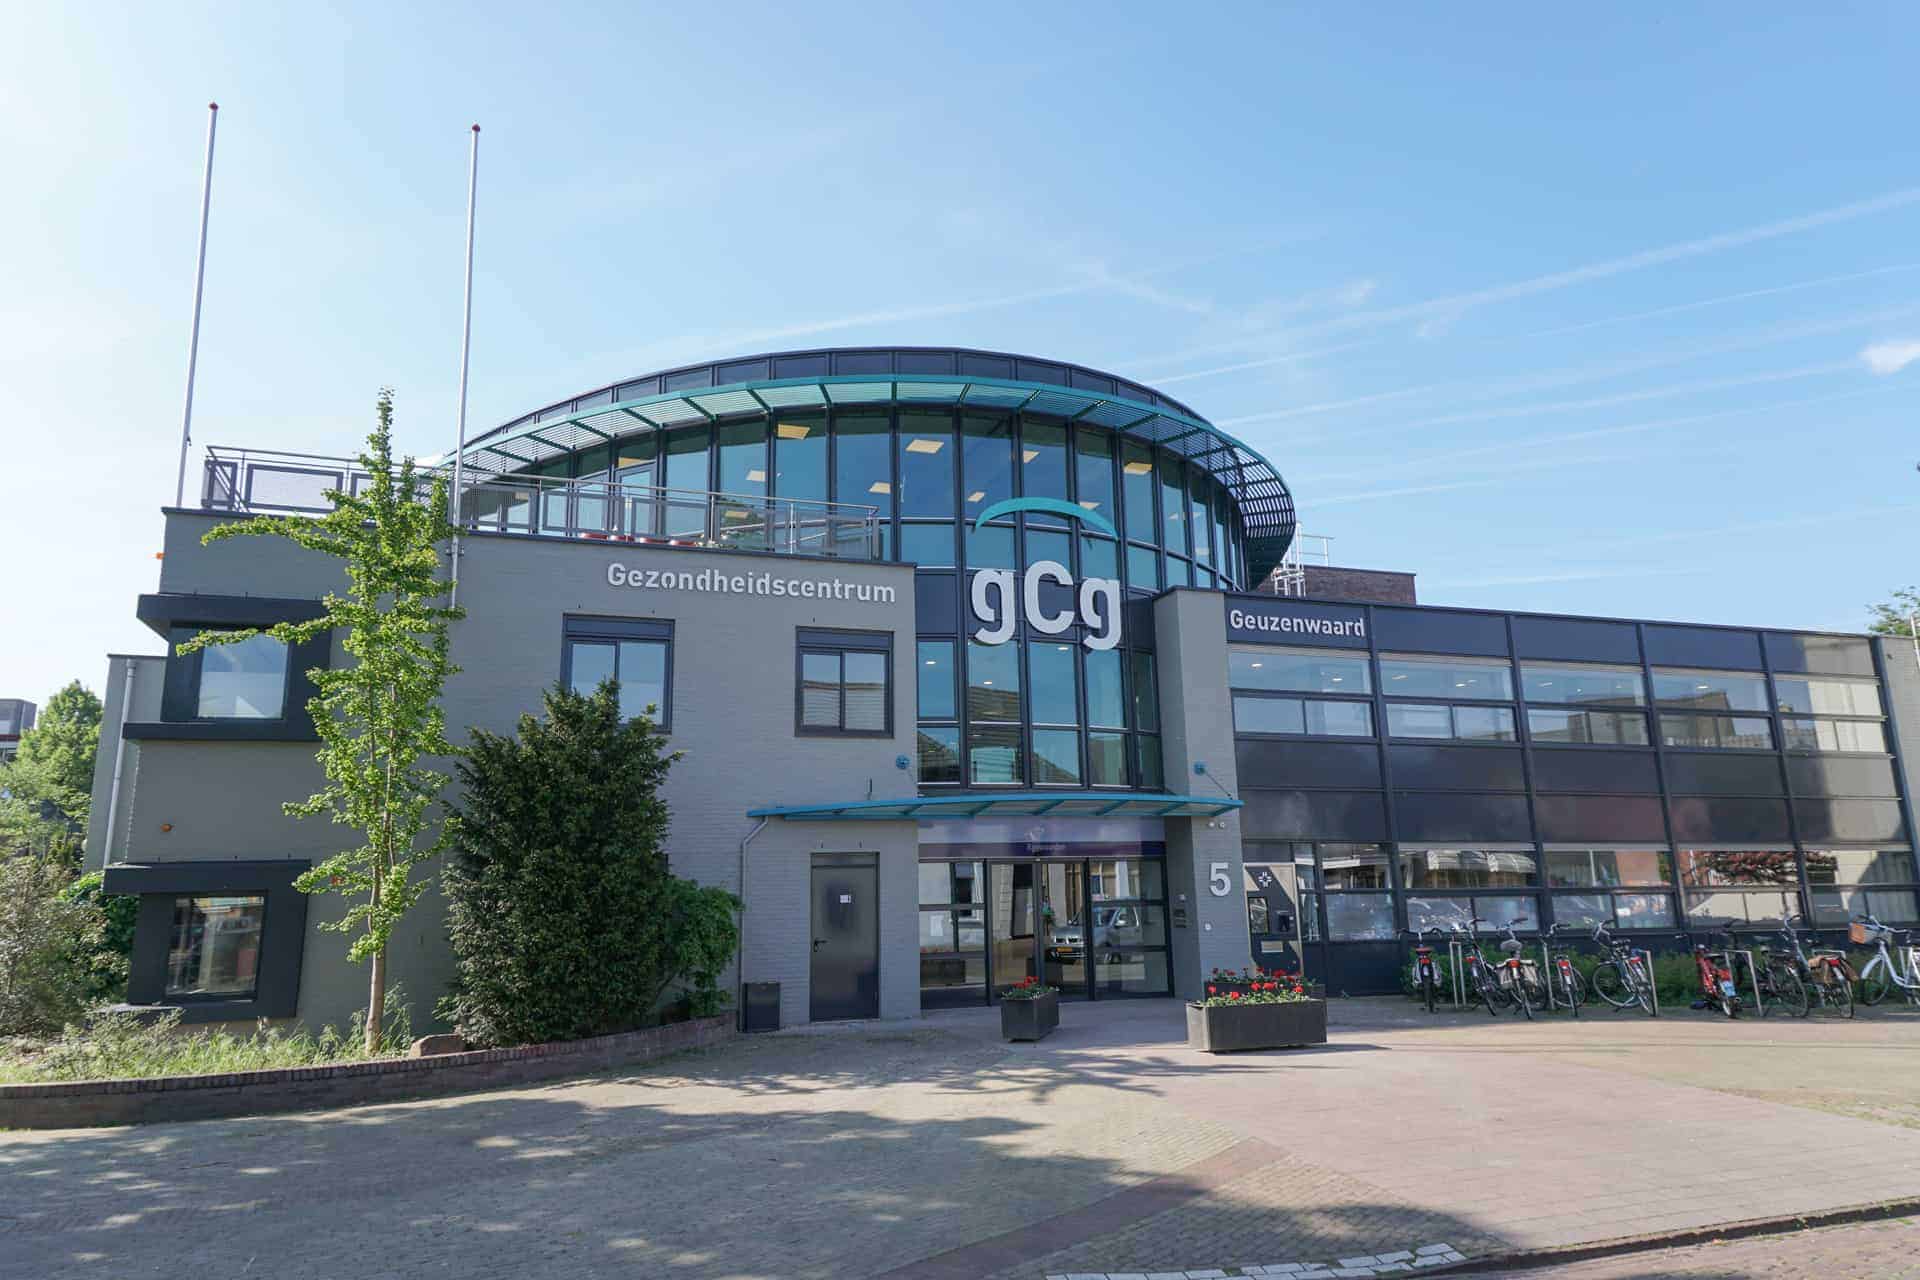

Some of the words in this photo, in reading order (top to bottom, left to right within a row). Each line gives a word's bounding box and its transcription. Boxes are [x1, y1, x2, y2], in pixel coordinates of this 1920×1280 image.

[607, 562, 896, 603] Gezondheidscentrum
[1230, 609, 1365, 637] Geuzenwaard
[1210, 862, 1231, 897] 5
